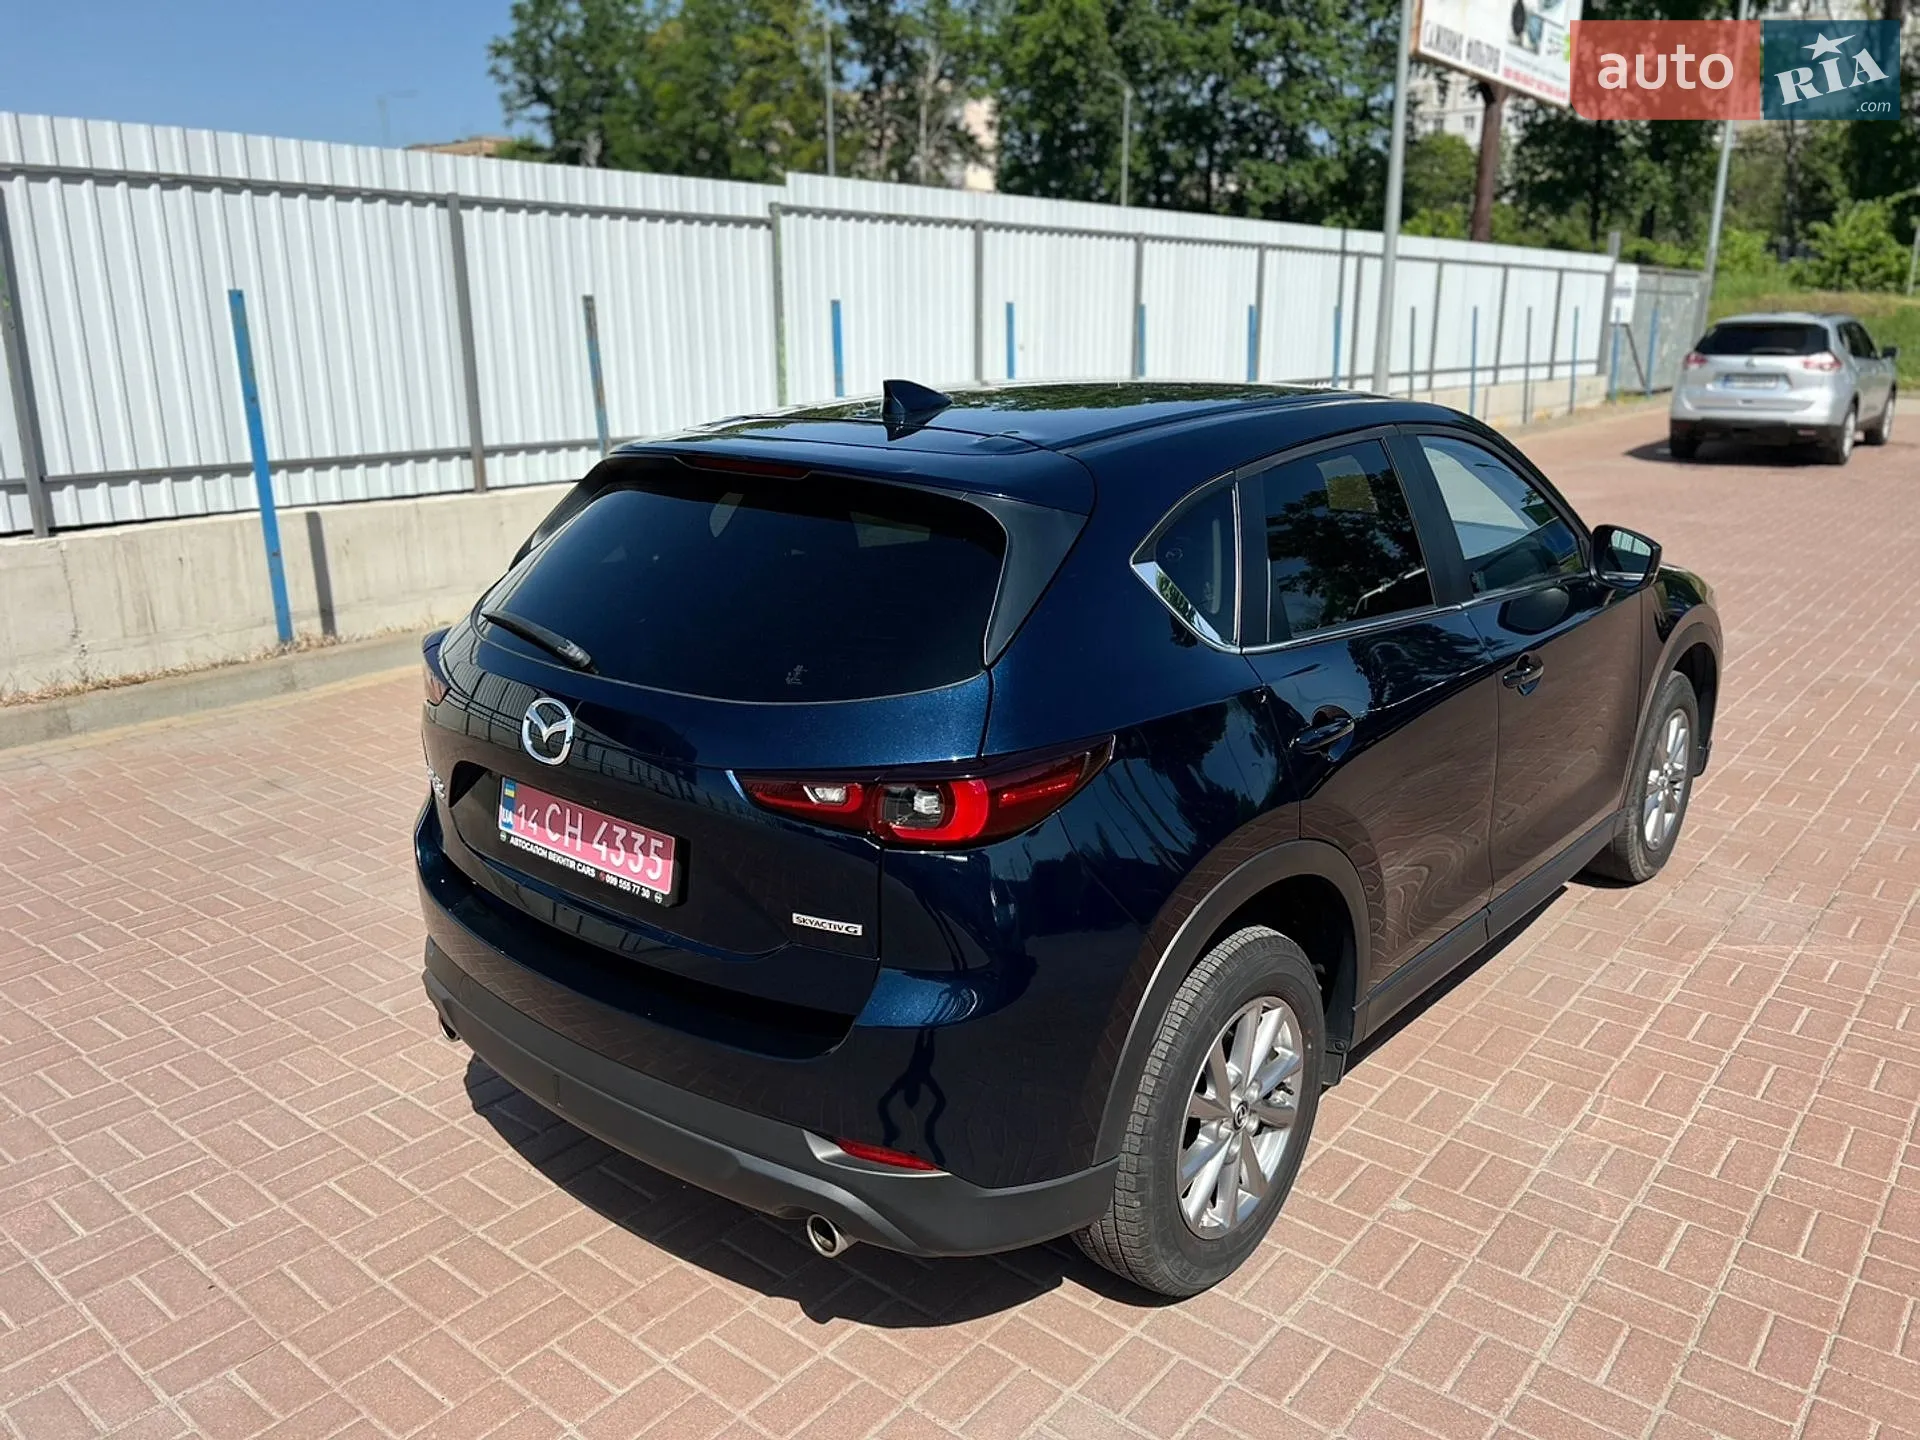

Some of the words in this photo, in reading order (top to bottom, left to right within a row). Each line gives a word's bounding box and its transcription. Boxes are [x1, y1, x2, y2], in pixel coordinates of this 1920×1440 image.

[509, 836, 548, 857] АВТОСАЛОН
[577, 862, 595, 878] CARS
[630, 883, 641, 895] 77
[517, 803, 539, 835] 14
[545, 803, 583, 851] CH
[592, 821, 664, 880] 4335
